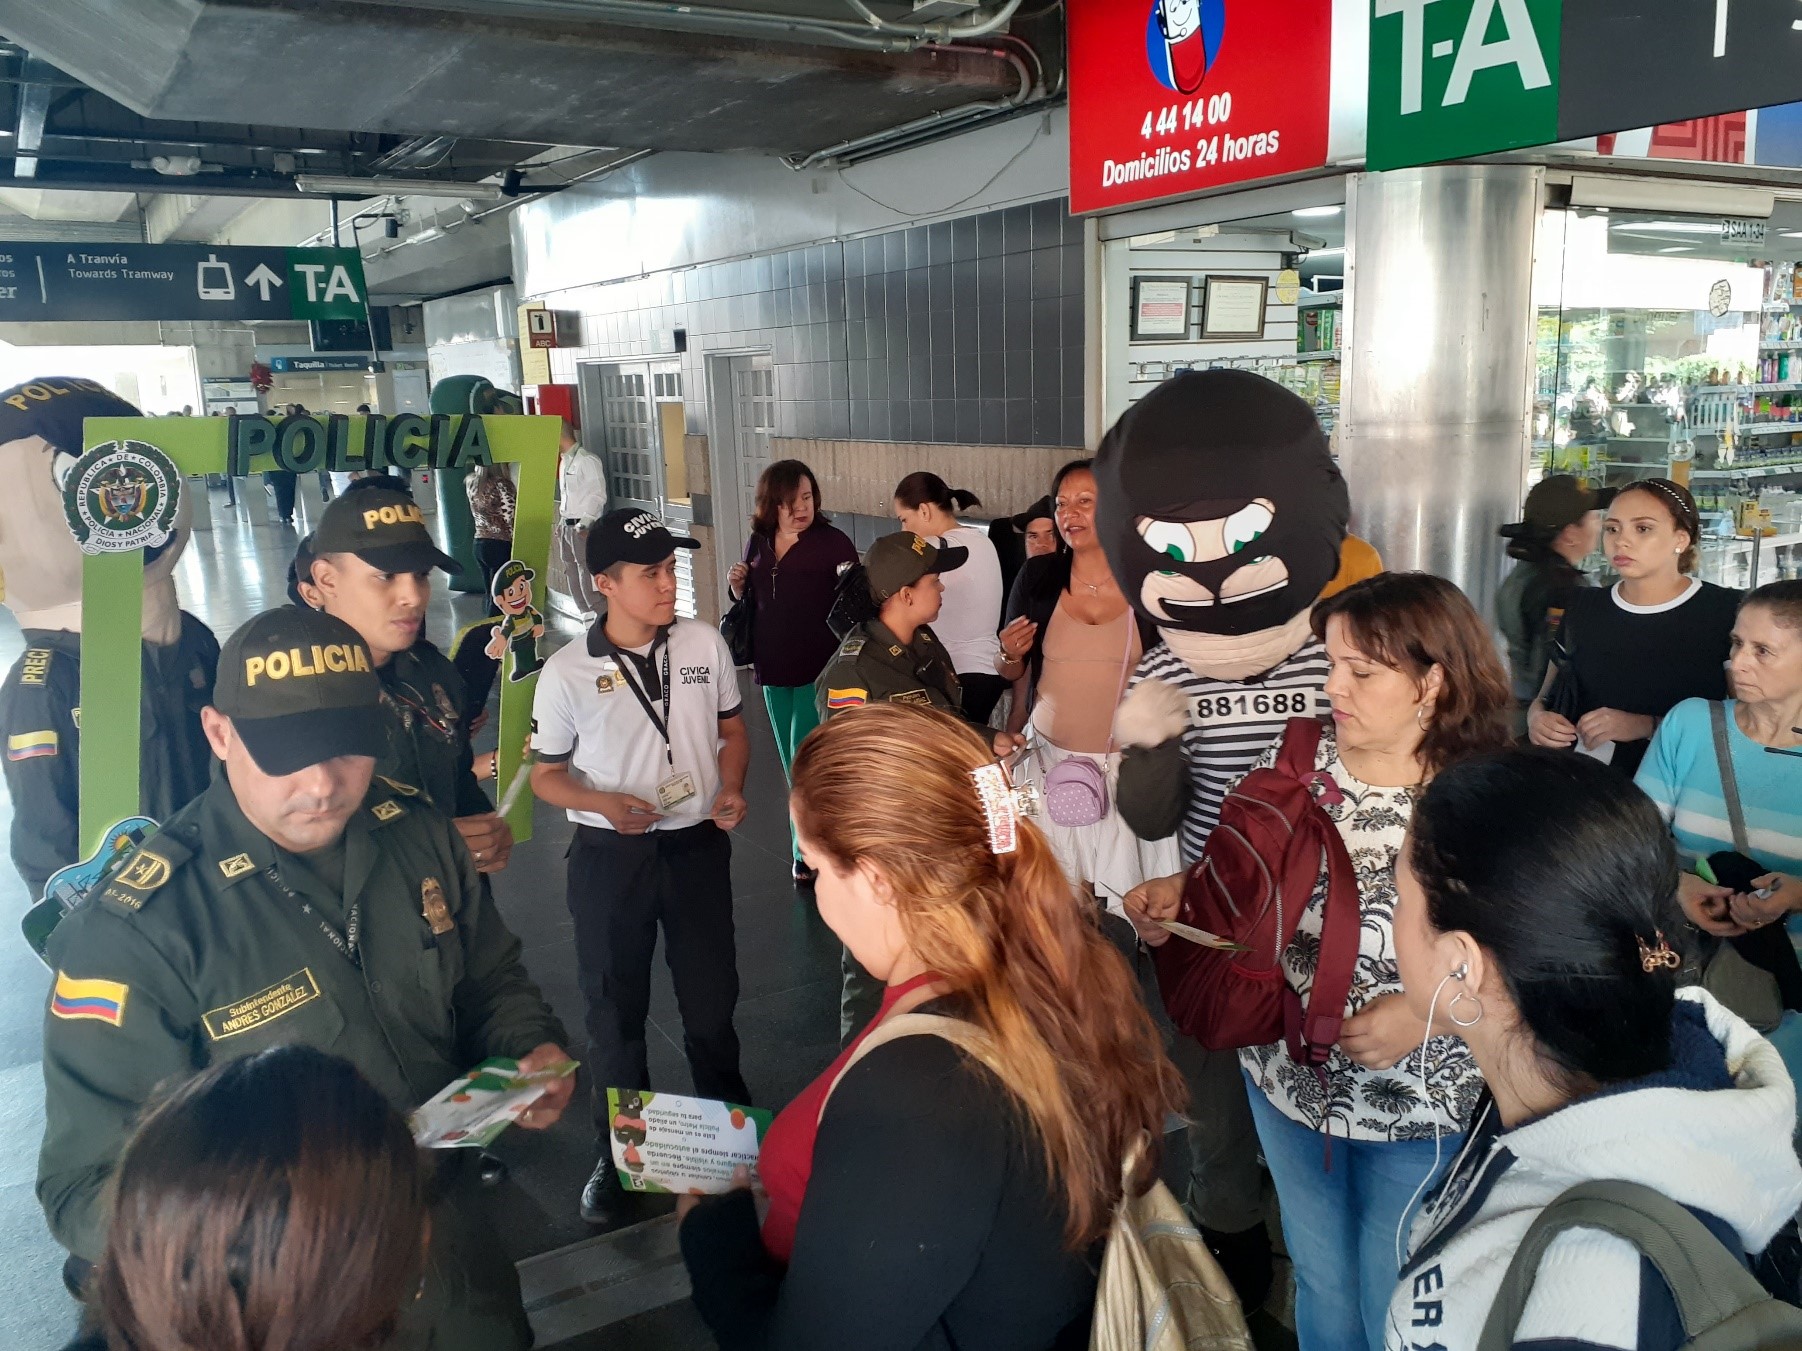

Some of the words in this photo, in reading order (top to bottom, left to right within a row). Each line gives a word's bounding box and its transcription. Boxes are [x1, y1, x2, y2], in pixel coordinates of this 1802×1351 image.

[1375, 0, 1552, 117] T-A
[1140, 111, 1153, 139] 4
[1155, 104, 1178, 136] 44
[1182, 98, 1204, 130] 14
[1207, 92, 1232, 125] 00
[1102, 146, 1191, 187] Domicilios
[1195, 135, 1219, 168] 24
[1222, 129, 1280, 163] horas
[67, 254, 76, 264] A
[79, 253, 128, 264] Tranvía
[68, 269, 118, 279] Towards
[121, 269, 174, 281] Tramway
[294, 264, 360, 303] T-A
[293, 361, 325, 370] Taquilla
[229, 414, 493, 476] POLICIA
[79, 460, 107, 507] REPUBLICA
[138, 457, 167, 499] COLOMBIA
[85, 516, 115, 537] POLICIA
[125, 506, 163, 537] NACIONAL
[96, 537, 117, 548] DIOS
[125, 532, 154, 547] PATRIA
[245, 644, 370, 687] POLICIA
[679, 666, 711, 676] CIVICA
[681, 675, 711, 684] JUVENIL
[1196, 692, 1306, 719] 881688
[222, 1009, 261, 1033] ANDRES
[261, 985, 308, 1017] GONZALEZ
[229, 983, 292, 1018] Subintendente
[658, 1126, 684, 1135] mensaje
[701, 1149, 728, 1157] siempre
